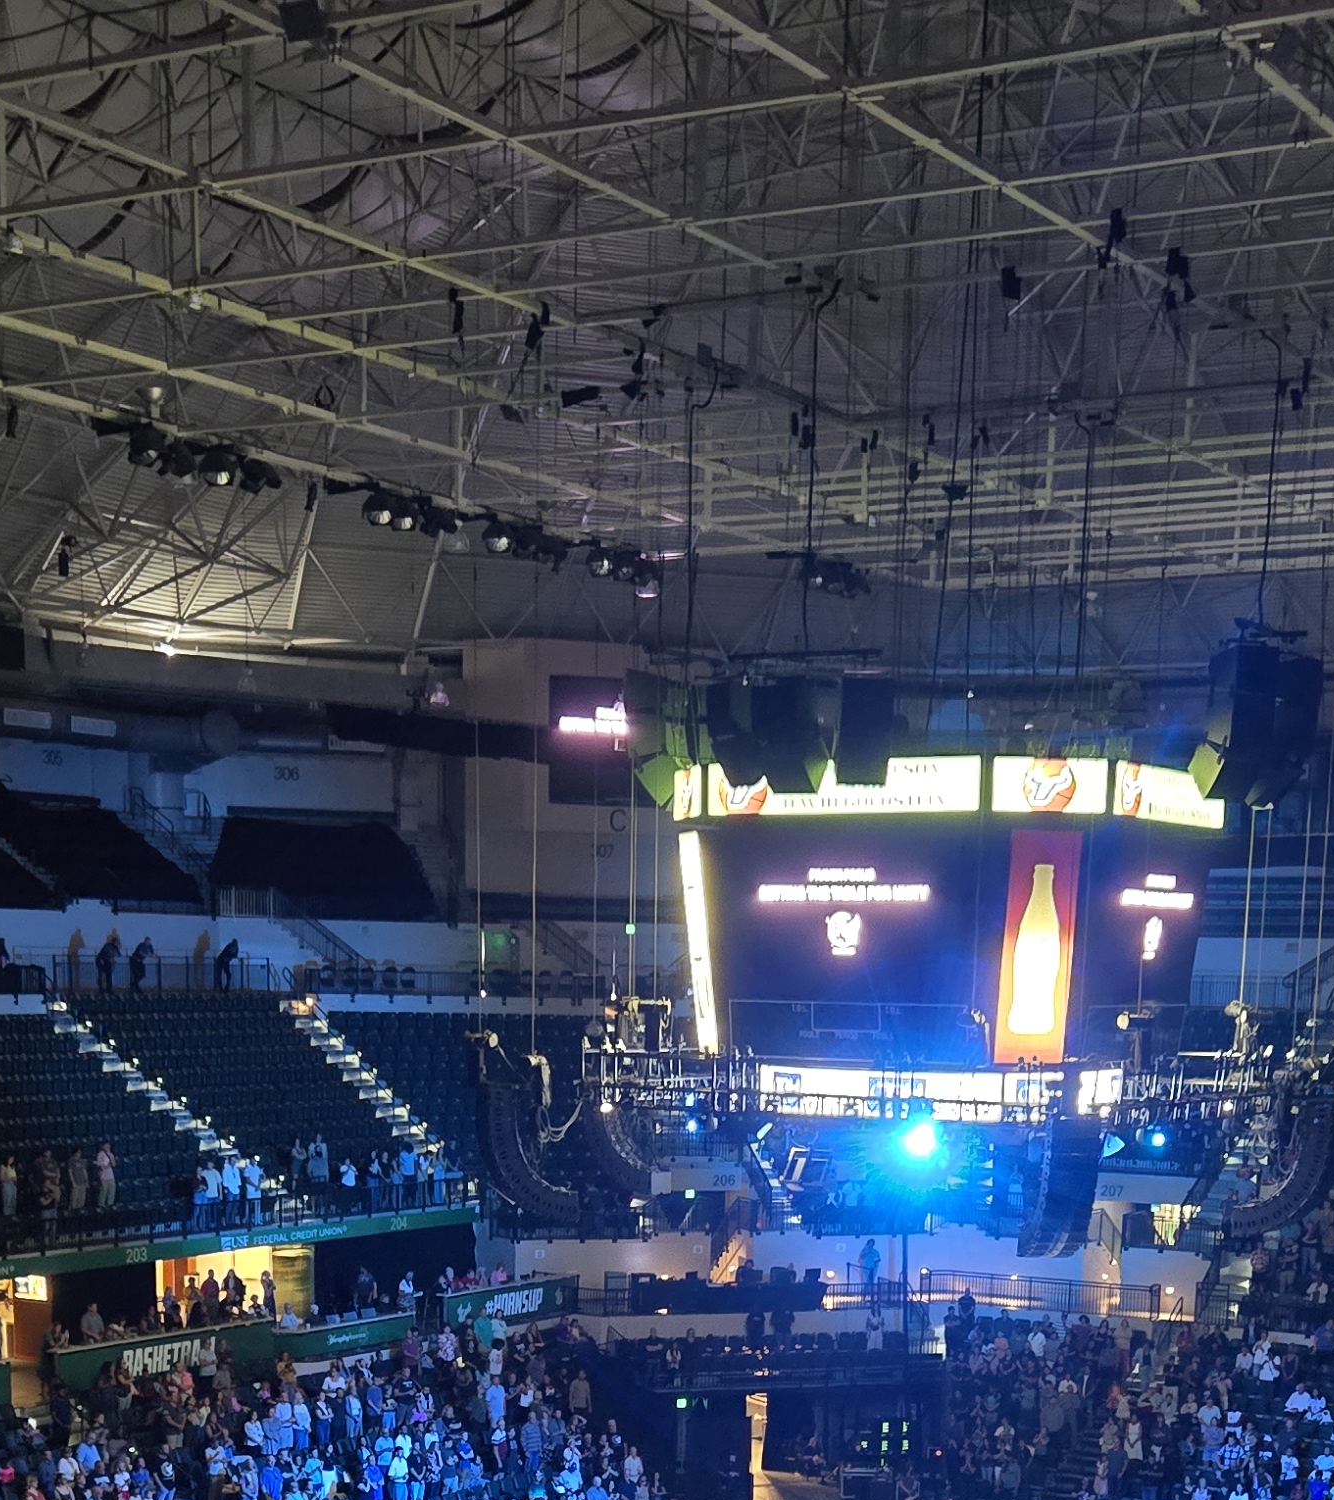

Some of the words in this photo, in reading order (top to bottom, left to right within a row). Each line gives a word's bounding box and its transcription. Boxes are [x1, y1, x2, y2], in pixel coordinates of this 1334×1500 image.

[42, 749, 63, 767] 305
[273, 765, 301, 783] 306
[609, 808, 627, 833] C
[712, 1174, 736, 1187] 206
[1101, 1184, 1123, 1197] 207
[390, 1216, 407, 1231] 204
[230, 1235, 249, 1249] USF
[253, 1233, 289, 1245] FEDERAL
[290, 1229, 317, 1242] CREDIT
[126, 1247, 148, 1264] 203
[485, 1287, 544, 1317] #HORNSUP
